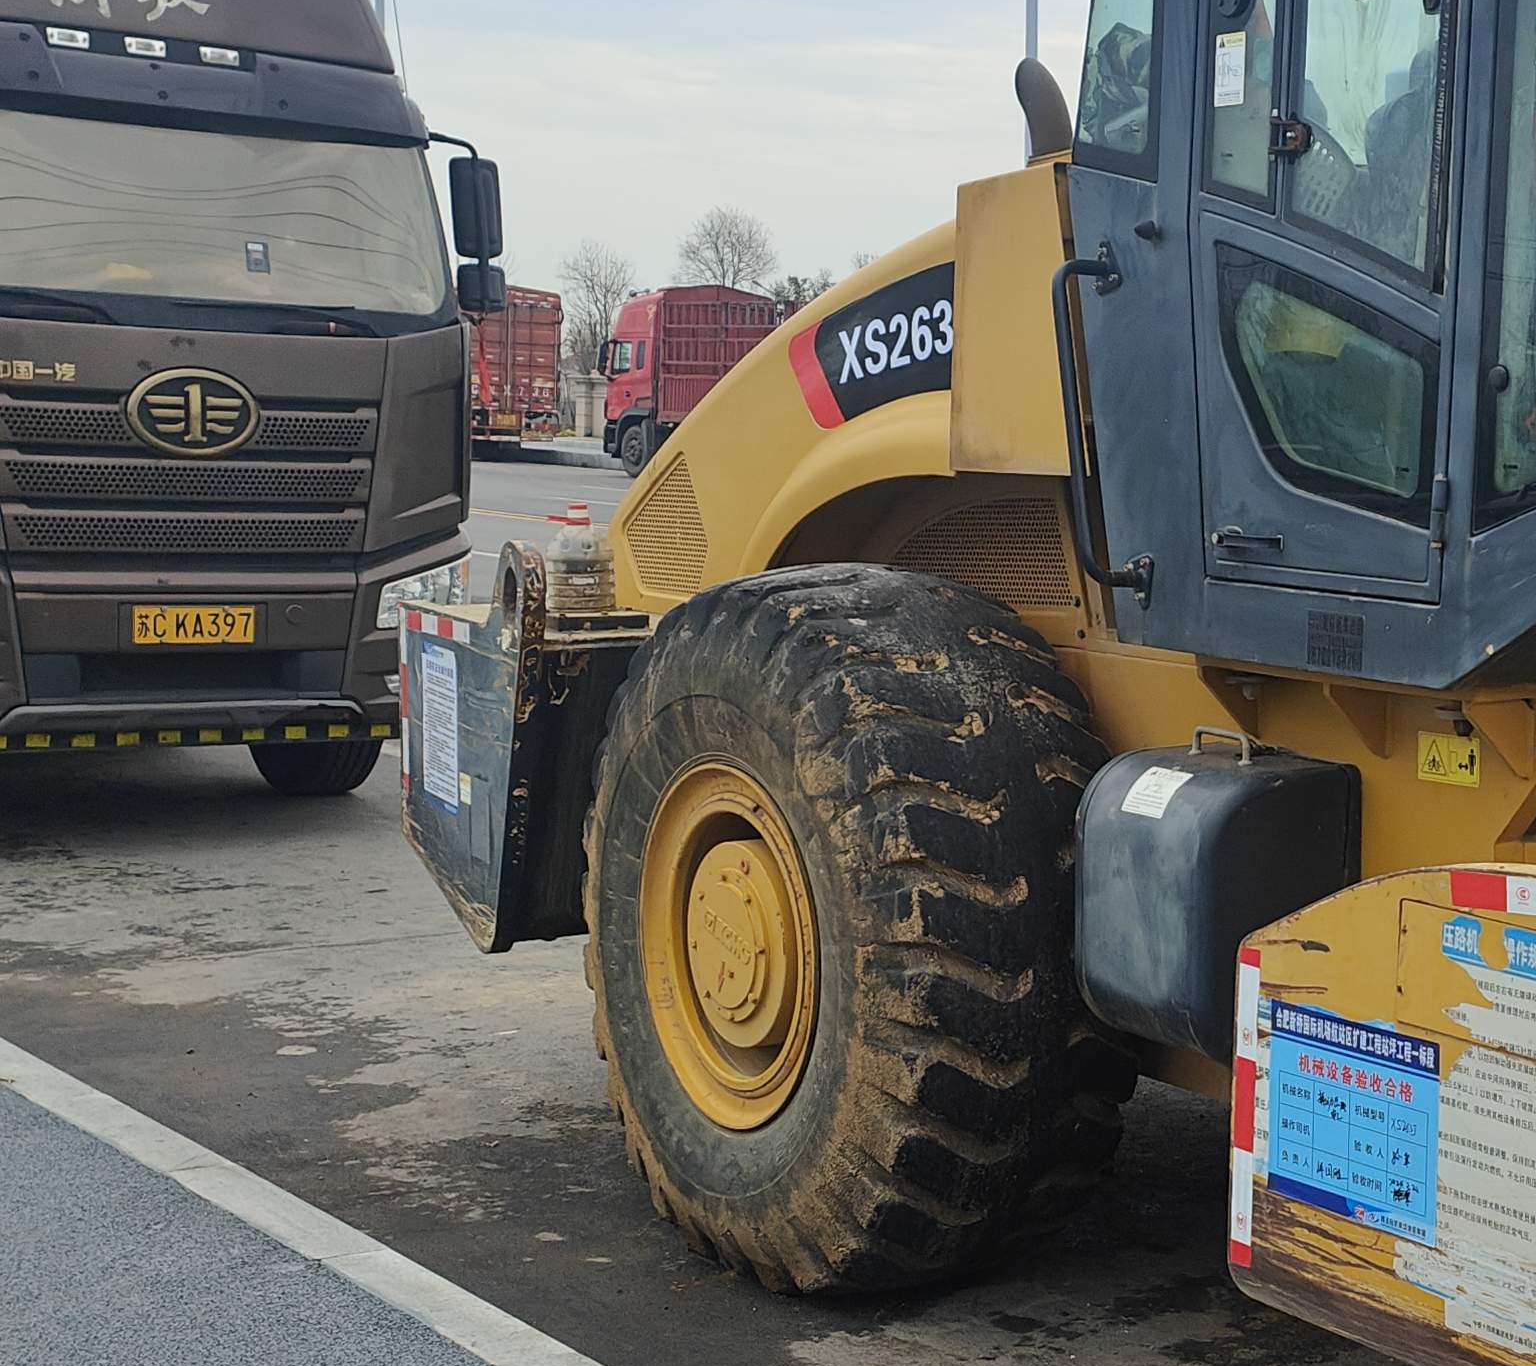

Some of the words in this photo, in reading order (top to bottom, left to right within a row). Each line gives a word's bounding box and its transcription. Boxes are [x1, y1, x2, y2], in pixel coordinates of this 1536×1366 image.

[839, 299, 954, 384] XS263
[1298, 1053, 1413, 1103] 机械设备验收合格
